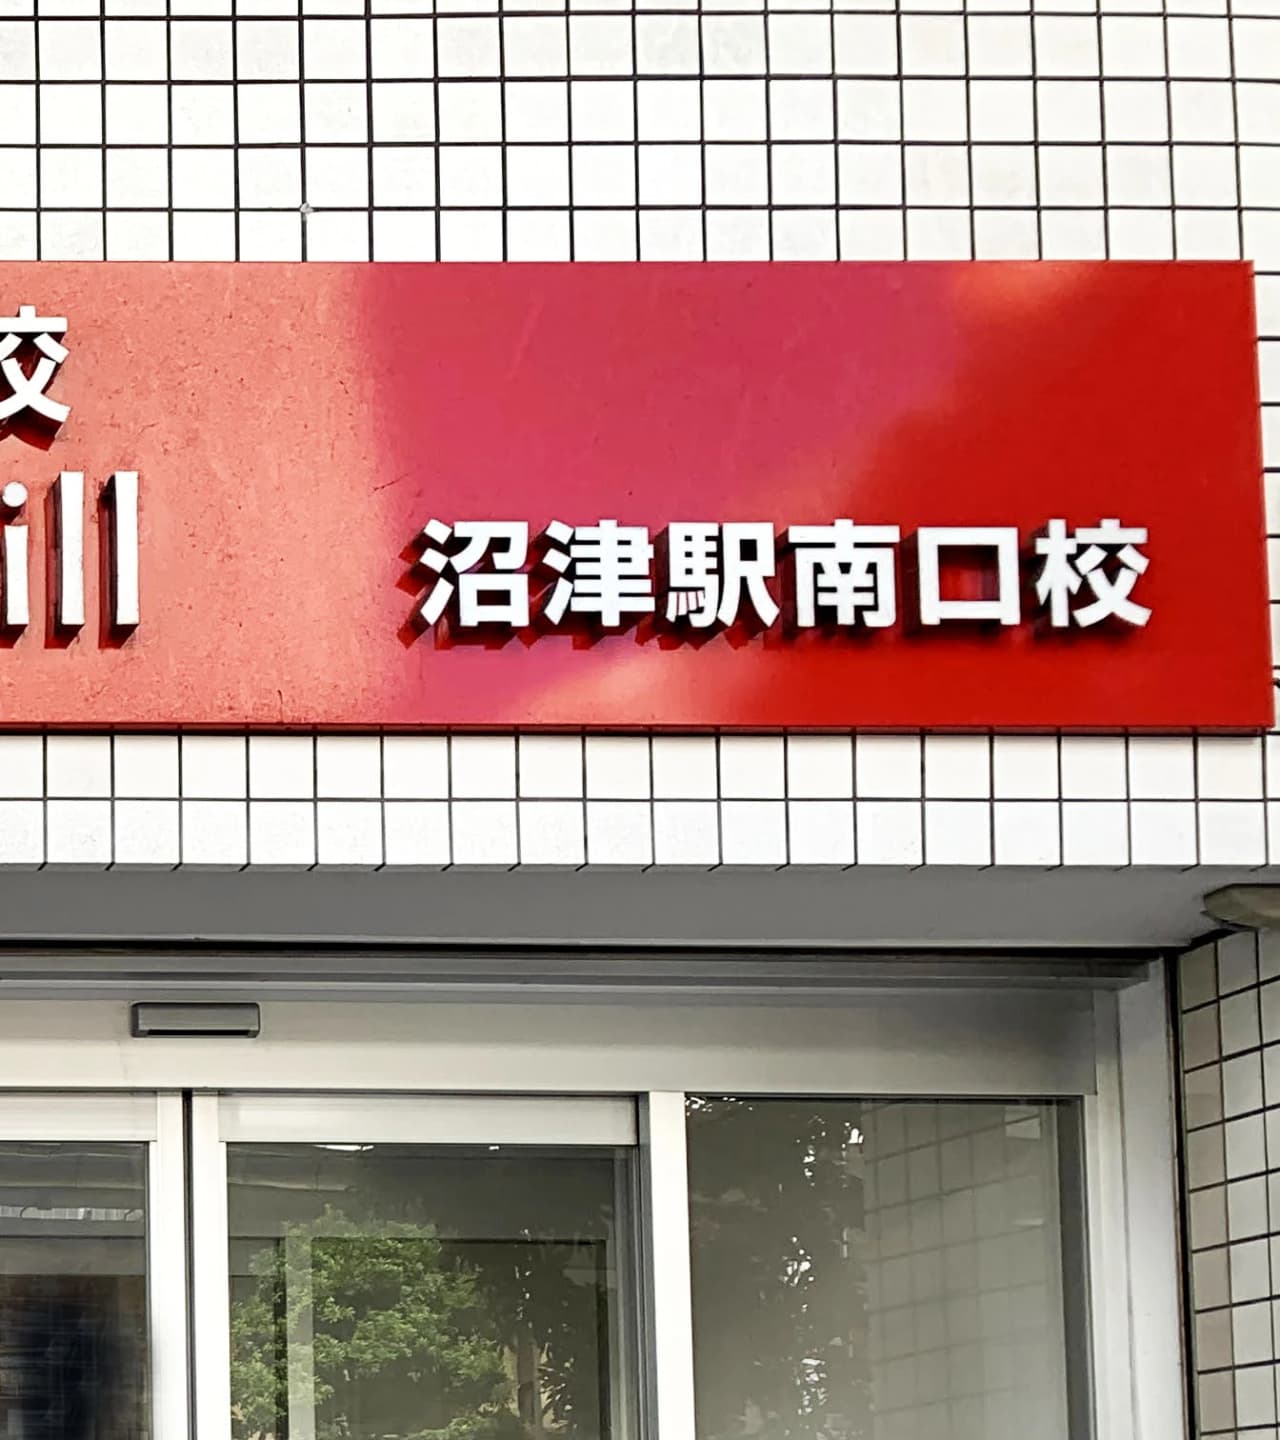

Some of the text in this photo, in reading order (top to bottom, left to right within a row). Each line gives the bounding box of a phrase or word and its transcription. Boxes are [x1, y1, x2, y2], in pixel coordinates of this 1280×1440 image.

[421, 517, 1152, 629] 沼津駅南口校
